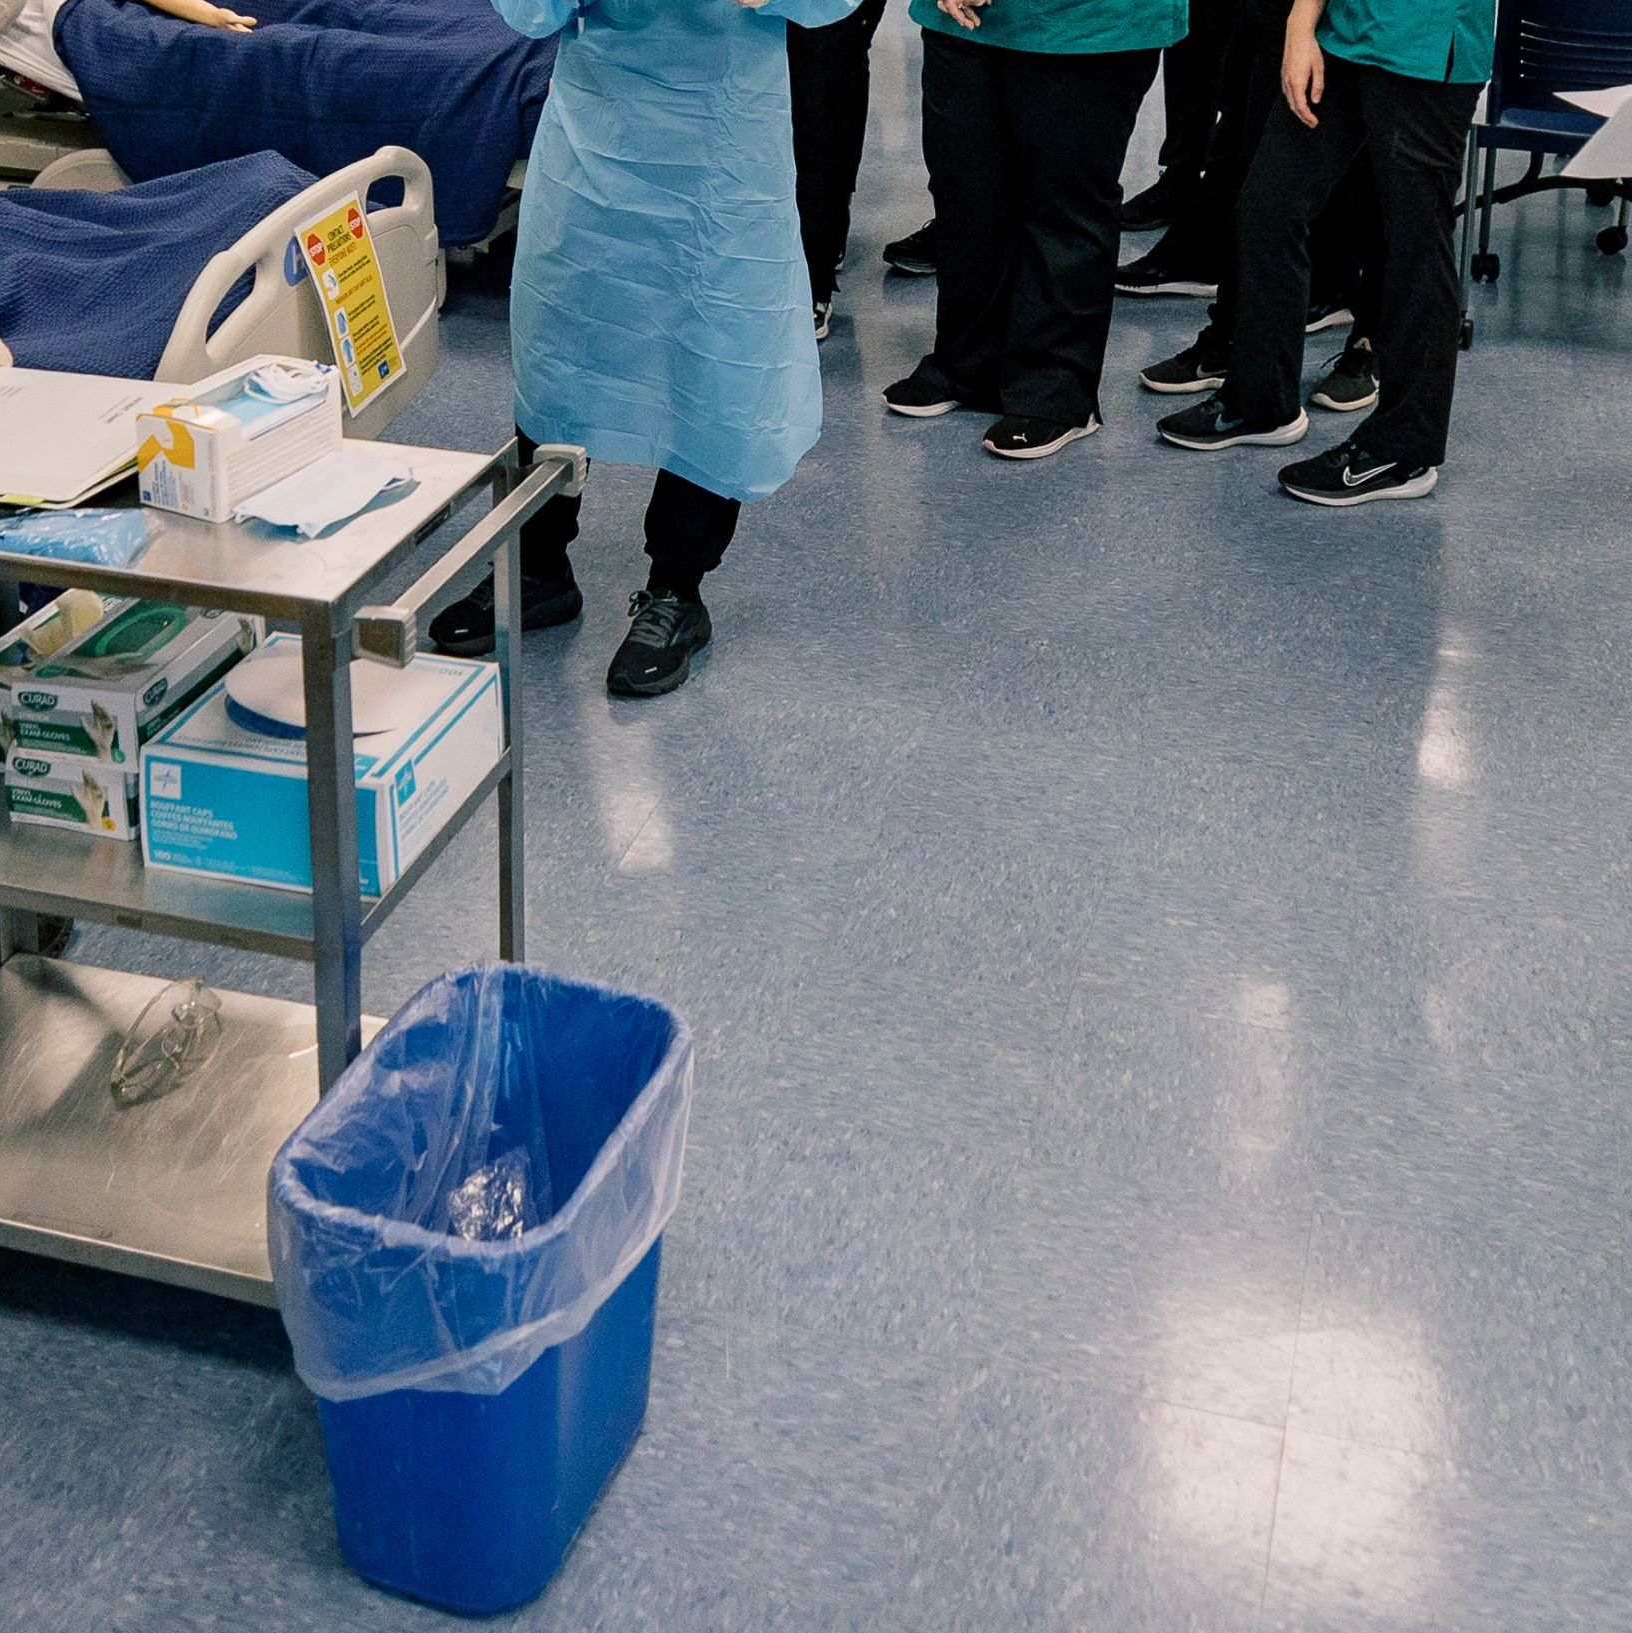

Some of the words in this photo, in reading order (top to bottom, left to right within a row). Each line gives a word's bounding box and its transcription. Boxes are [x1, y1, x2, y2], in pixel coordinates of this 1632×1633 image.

[349, 216, 362, 231] STOP
[309, 241, 324, 258] STOP
[20, 693, 56, 707] CURAD
[41, 731, 71, 742] GLOVES
[15, 758, 51, 773] CURAD
[33, 797, 63, 810] GLOVES
[150, 800, 191, 815] BOUFFANT
[192, 808, 214, 818] CAPS
[179, 824, 190, 833] DE
